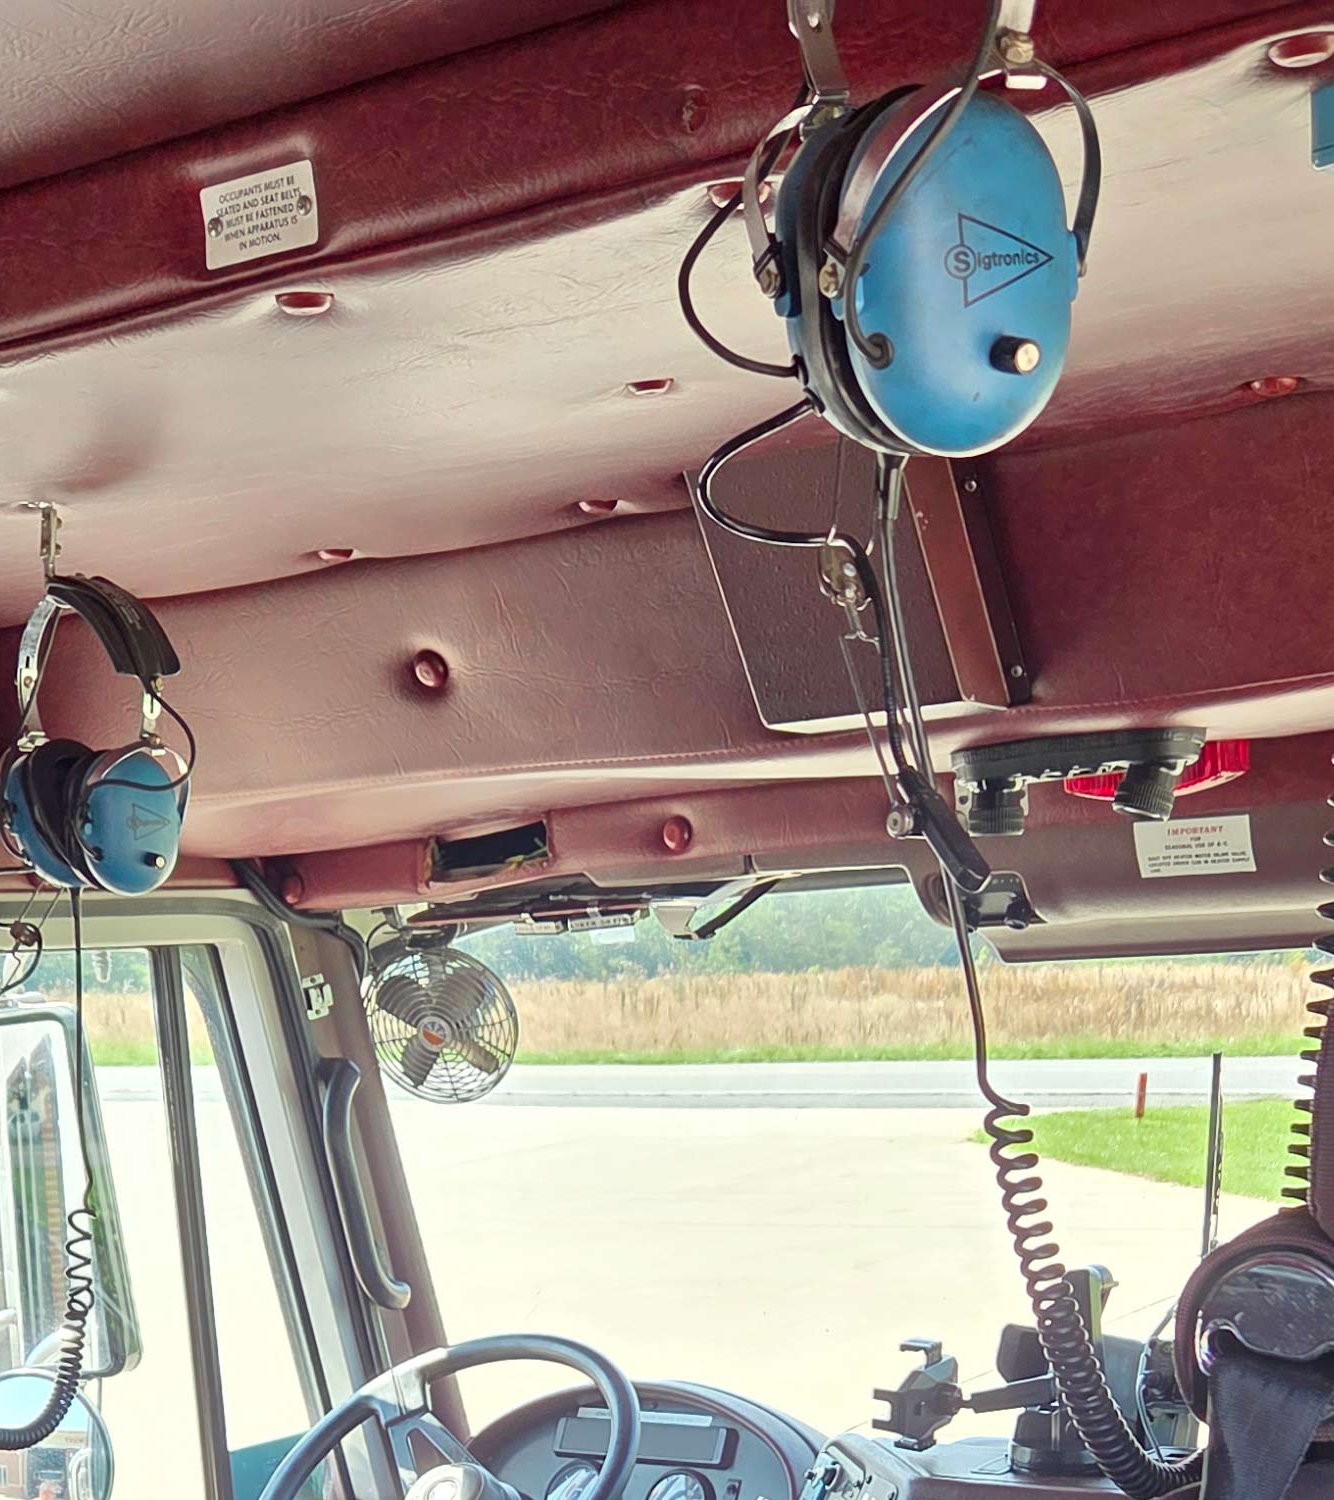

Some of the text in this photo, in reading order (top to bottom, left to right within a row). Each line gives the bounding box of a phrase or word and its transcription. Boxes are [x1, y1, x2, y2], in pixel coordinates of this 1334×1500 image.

[218, 175, 295, 204] OCCUPANTS MUST BE
[216, 203, 242, 218] SEATED
[242, 198, 260, 210] AND
[260, 193, 280, 206] SEAT
[225, 202, 294, 228] MUST BE FASTENED
[224, 214, 299, 242] WHEN APPARATUS IS
[238, 241, 247, 251] IN
[953, 247, 1040, 284] Sigtronics
[1167, 825, 1224, 836] IMPORTANT
